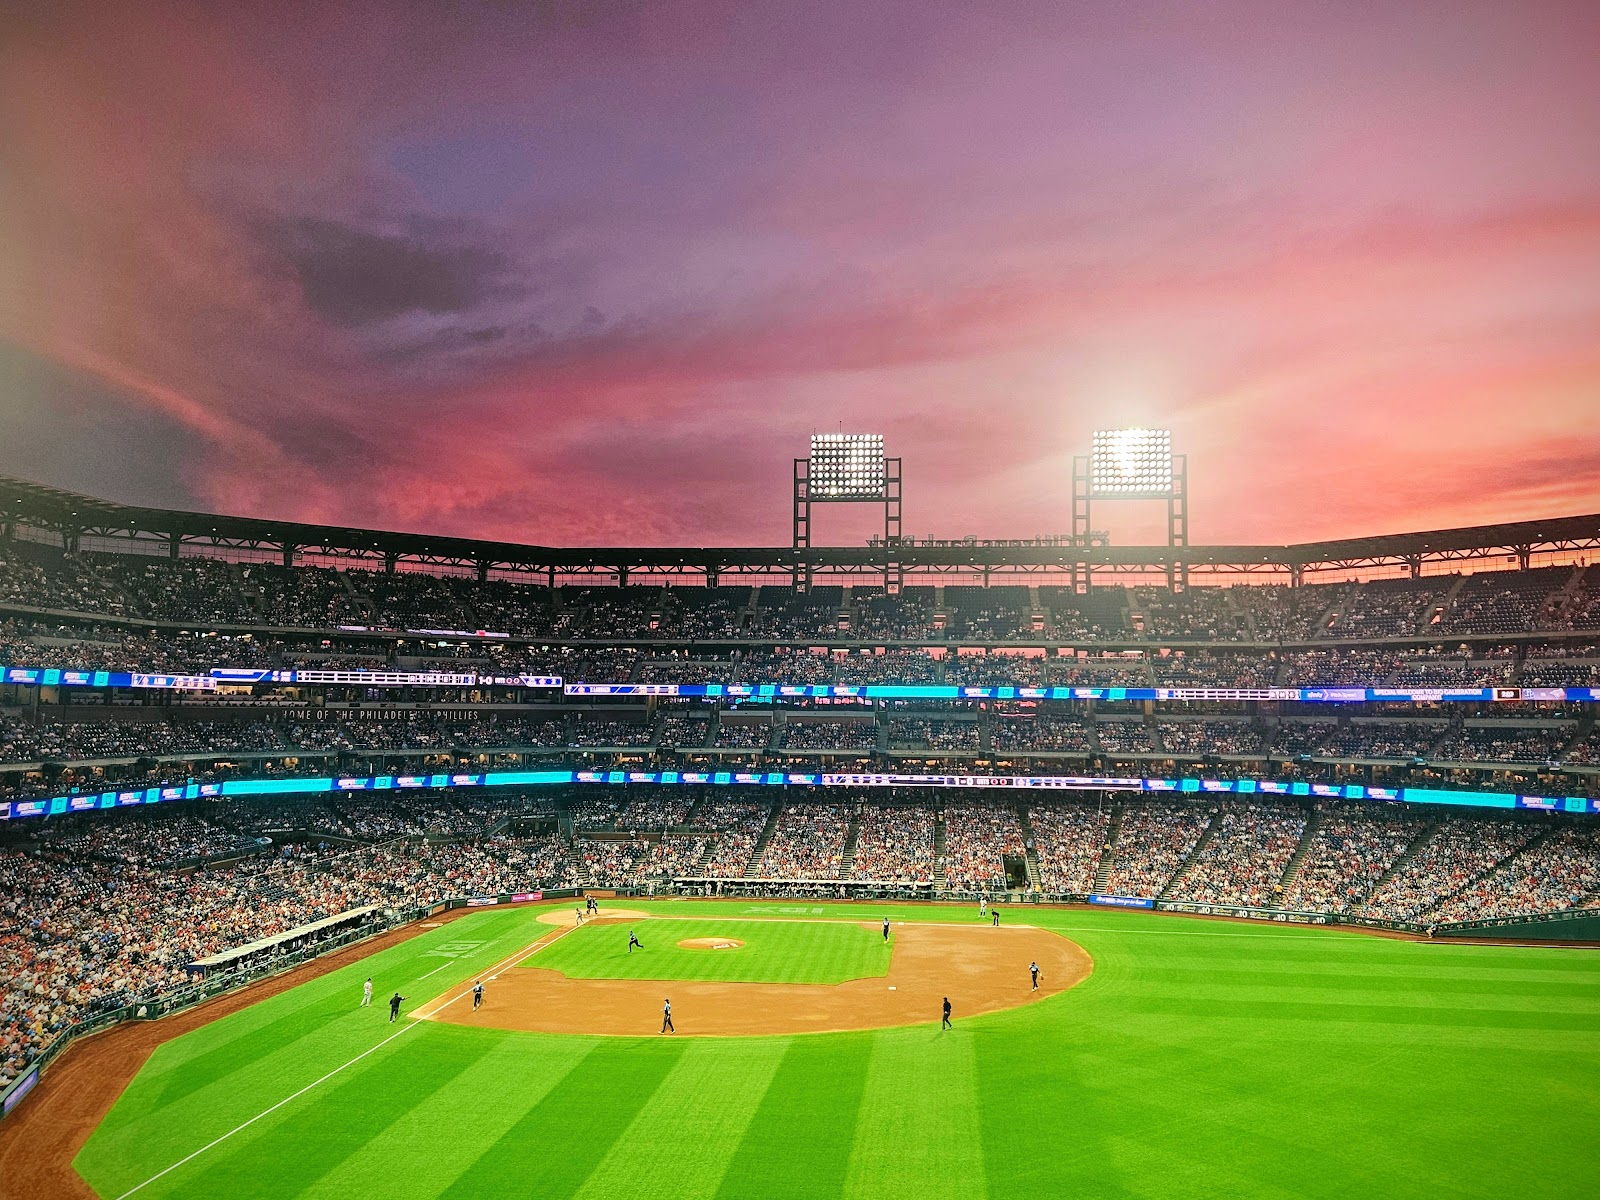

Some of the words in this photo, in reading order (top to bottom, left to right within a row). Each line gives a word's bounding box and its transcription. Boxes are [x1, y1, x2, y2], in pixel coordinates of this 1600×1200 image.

[283, 710, 311, 720] HOME
[317, 710, 329, 720] OF
[437, 710, 478, 720] PHILLIES
[1239, 910, 1248, 918] 10
